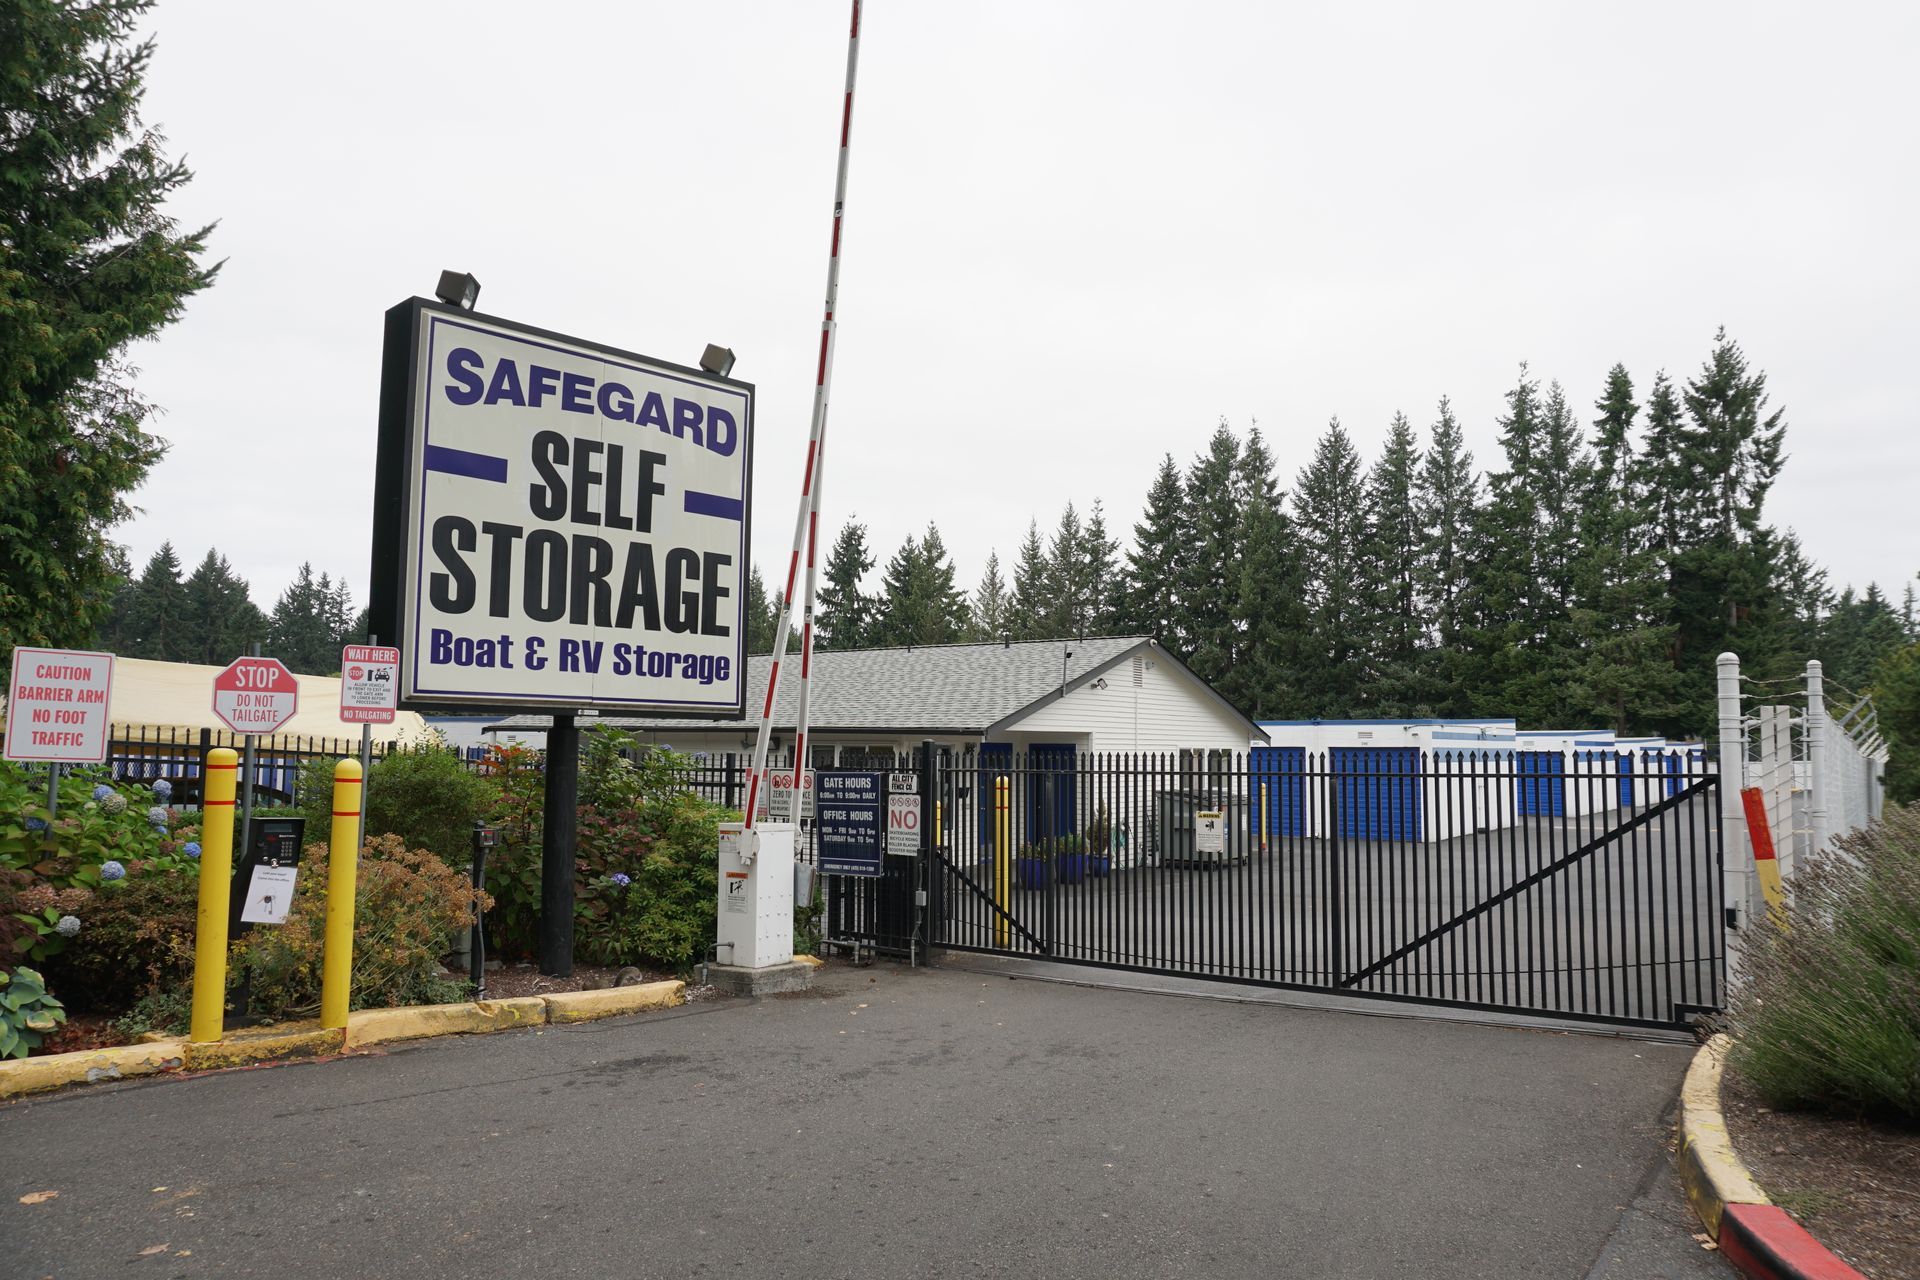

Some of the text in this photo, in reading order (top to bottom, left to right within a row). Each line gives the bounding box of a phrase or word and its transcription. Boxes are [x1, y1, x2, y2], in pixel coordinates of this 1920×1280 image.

[445, 348, 738, 457] SAFEGARD
[529, 430, 667, 533] SELF
[429, 516, 732, 638] STORAGE
[348, 648, 396, 662] WAIT HERE
[430, 628, 730, 685] Boat & RV Storage
[36, 664, 91, 681] CAUTION
[235, 666, 279, 689] STOP
[18, 686, 105, 704] BARRIER ARM
[237, 694, 275, 708] DO NOT
[32, 709, 87, 725] NO FOOT
[231, 708, 279, 723] TAILGATE
[344, 710, 391, 720] NO TAILGATING
[31, 731, 84, 747] TRAFFIC
[824, 778, 872, 789] GATE HOURS
[772, 790, 784, 798] ZERO
[862, 792, 876, 800] DAILY
[823, 810, 873, 821] OFFICE HOURS
[890, 810, 918, 829] NO
[822, 826, 833, 834] MON
[823, 834, 847, 842] SATURDAY
